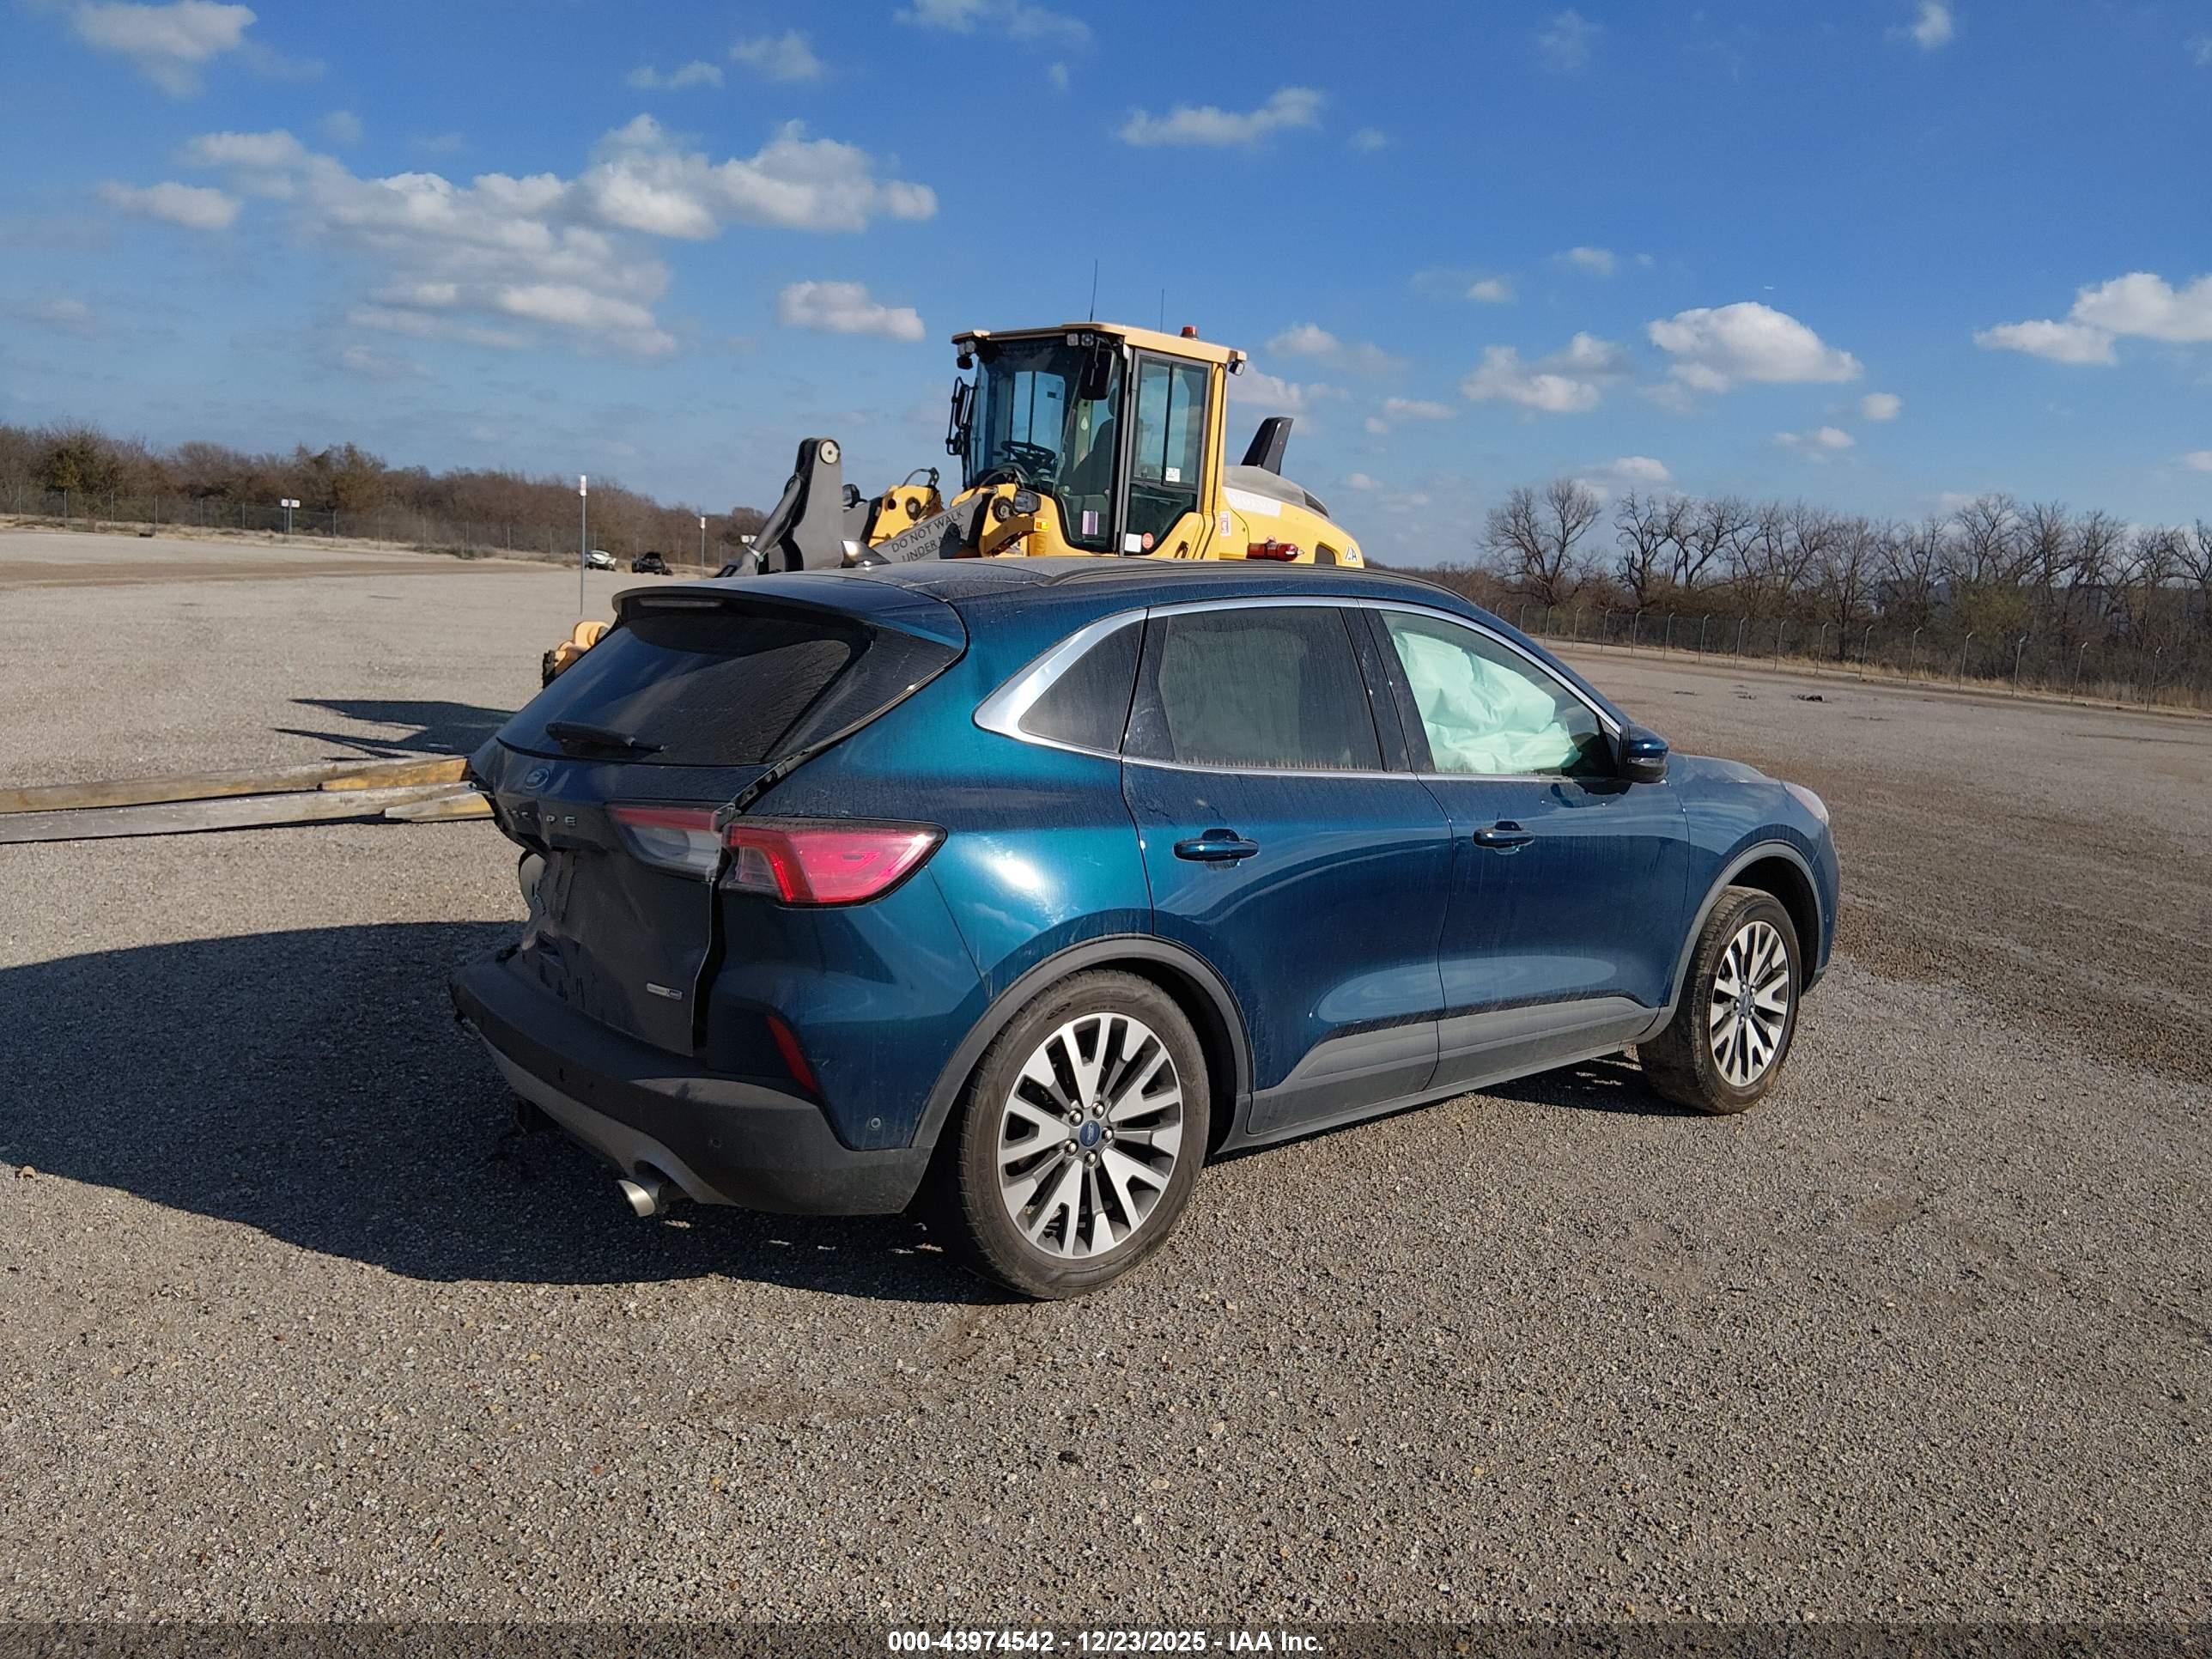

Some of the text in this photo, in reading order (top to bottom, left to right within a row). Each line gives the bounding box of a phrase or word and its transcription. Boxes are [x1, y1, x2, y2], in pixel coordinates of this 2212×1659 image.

[891, 538, 908, 553] DO
[910, 525, 933, 544] NOT
[933, 508, 964, 530] WALK
[902, 538, 938, 562] UNDER
